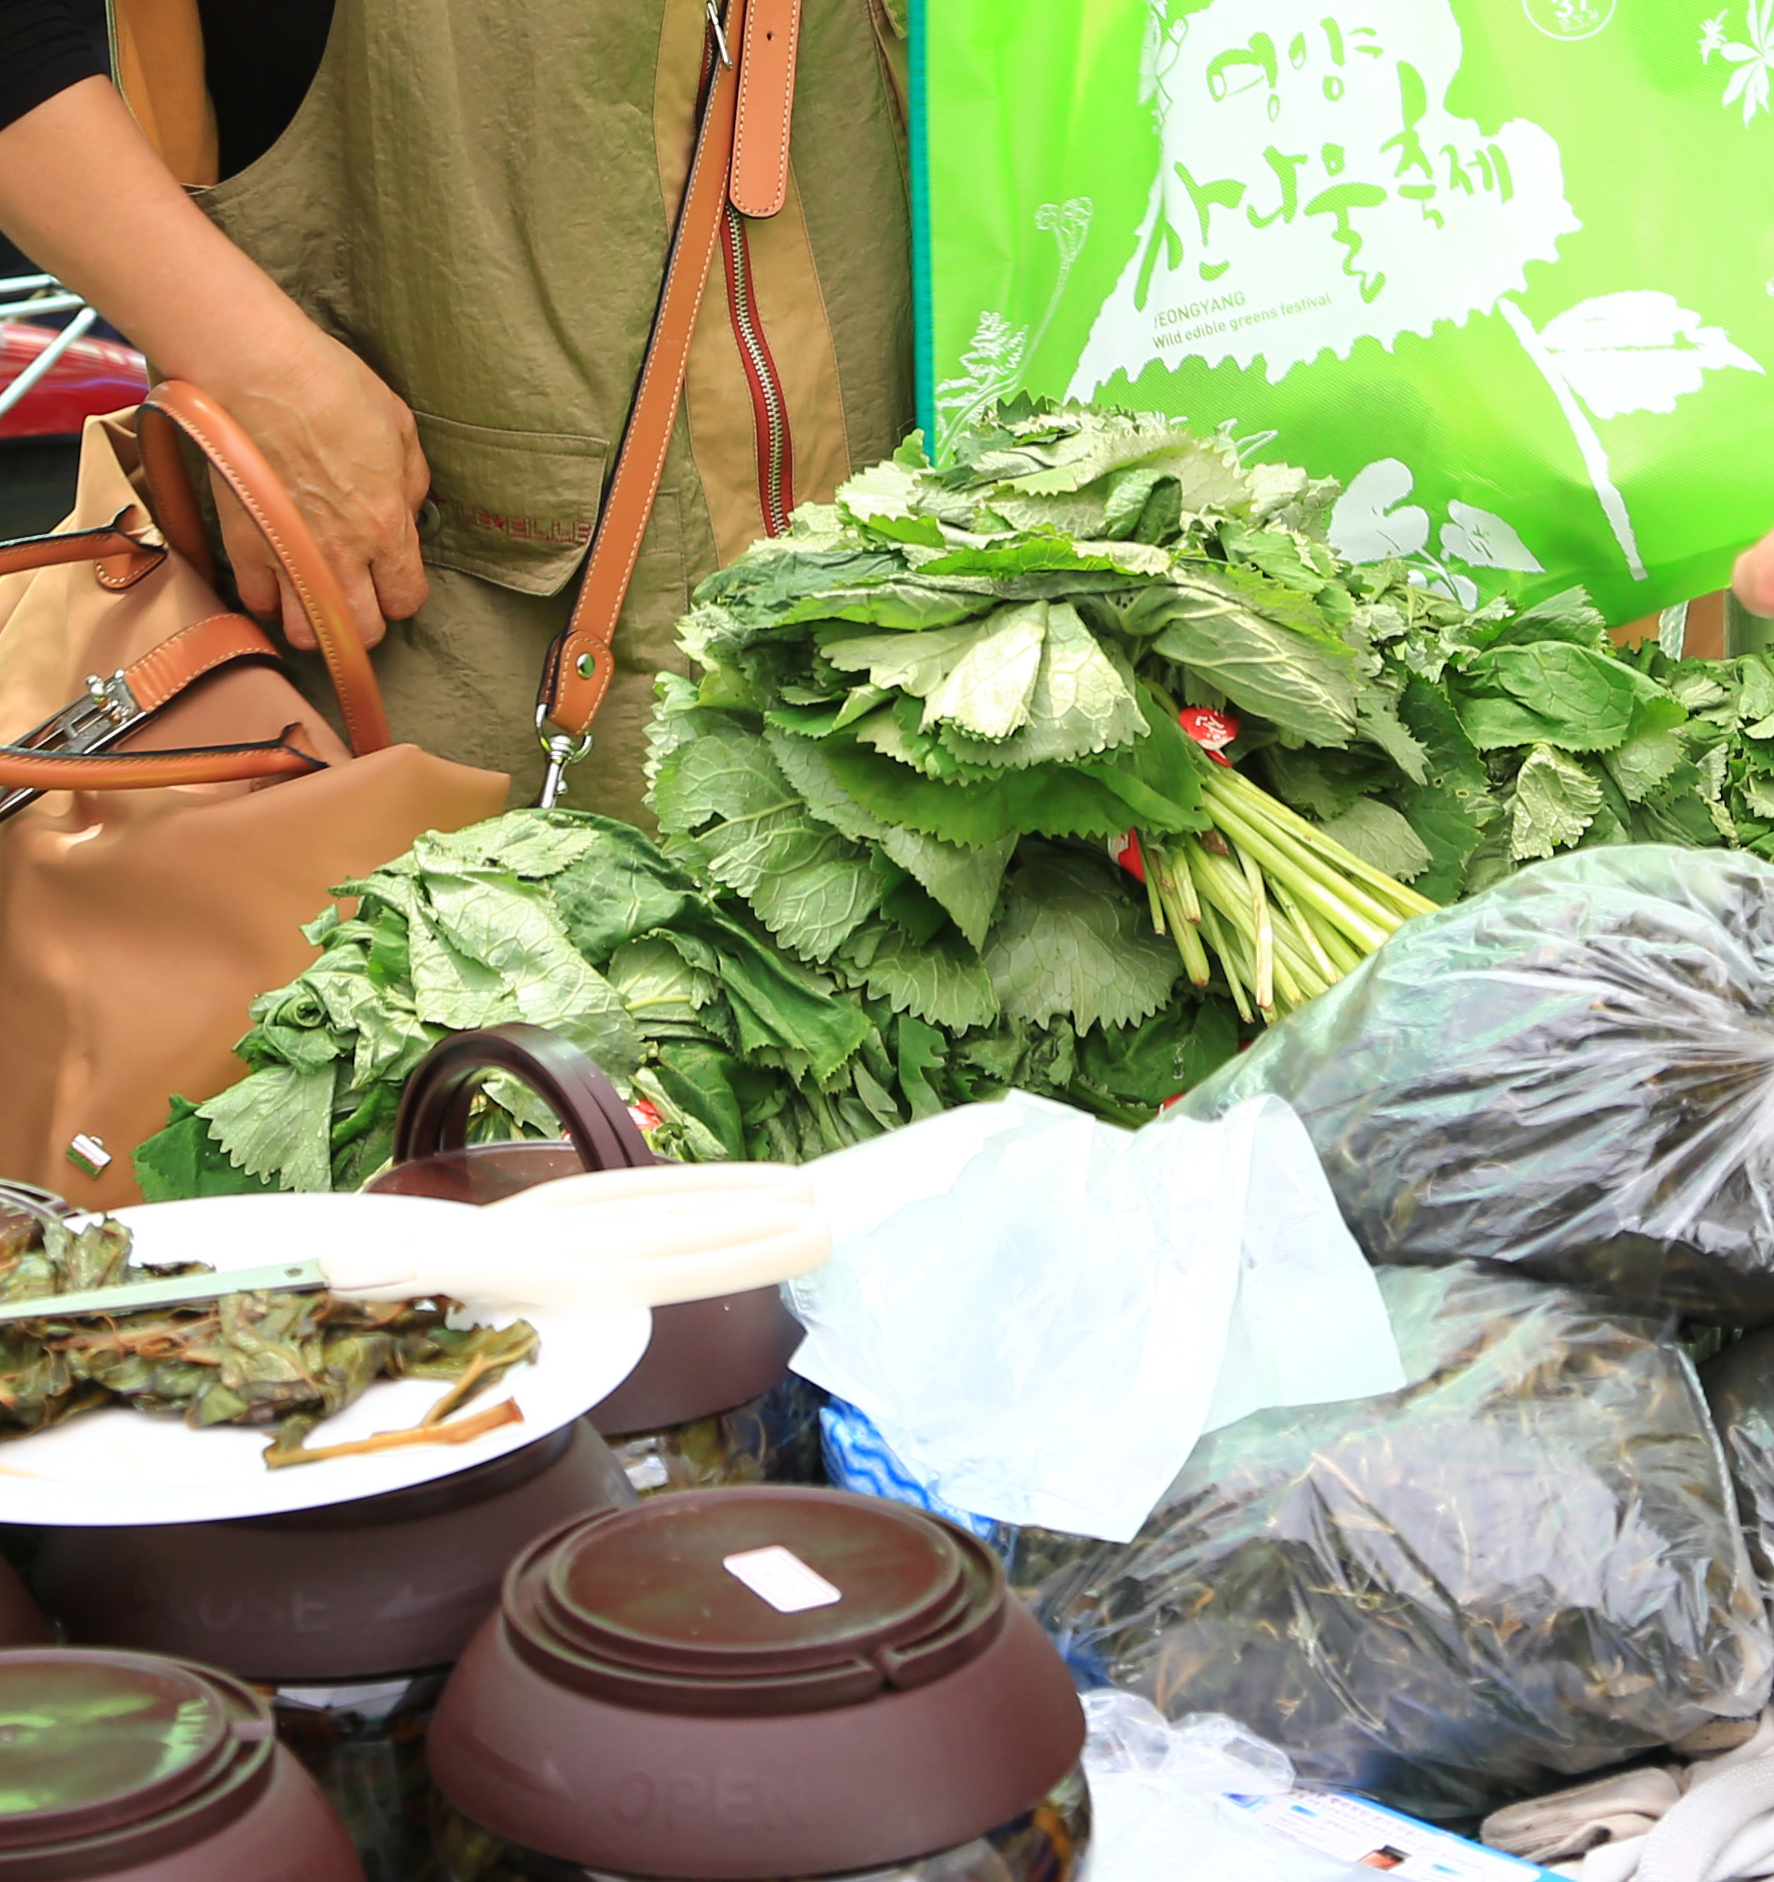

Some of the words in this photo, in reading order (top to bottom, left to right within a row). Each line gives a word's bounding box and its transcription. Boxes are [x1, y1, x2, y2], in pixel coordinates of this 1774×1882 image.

[1152, 330, 1182, 350] Wild
[1185, 319, 1227, 343] edible
[1230, 306, 1278, 333] greens
[1280, 291, 1333, 316] festival
